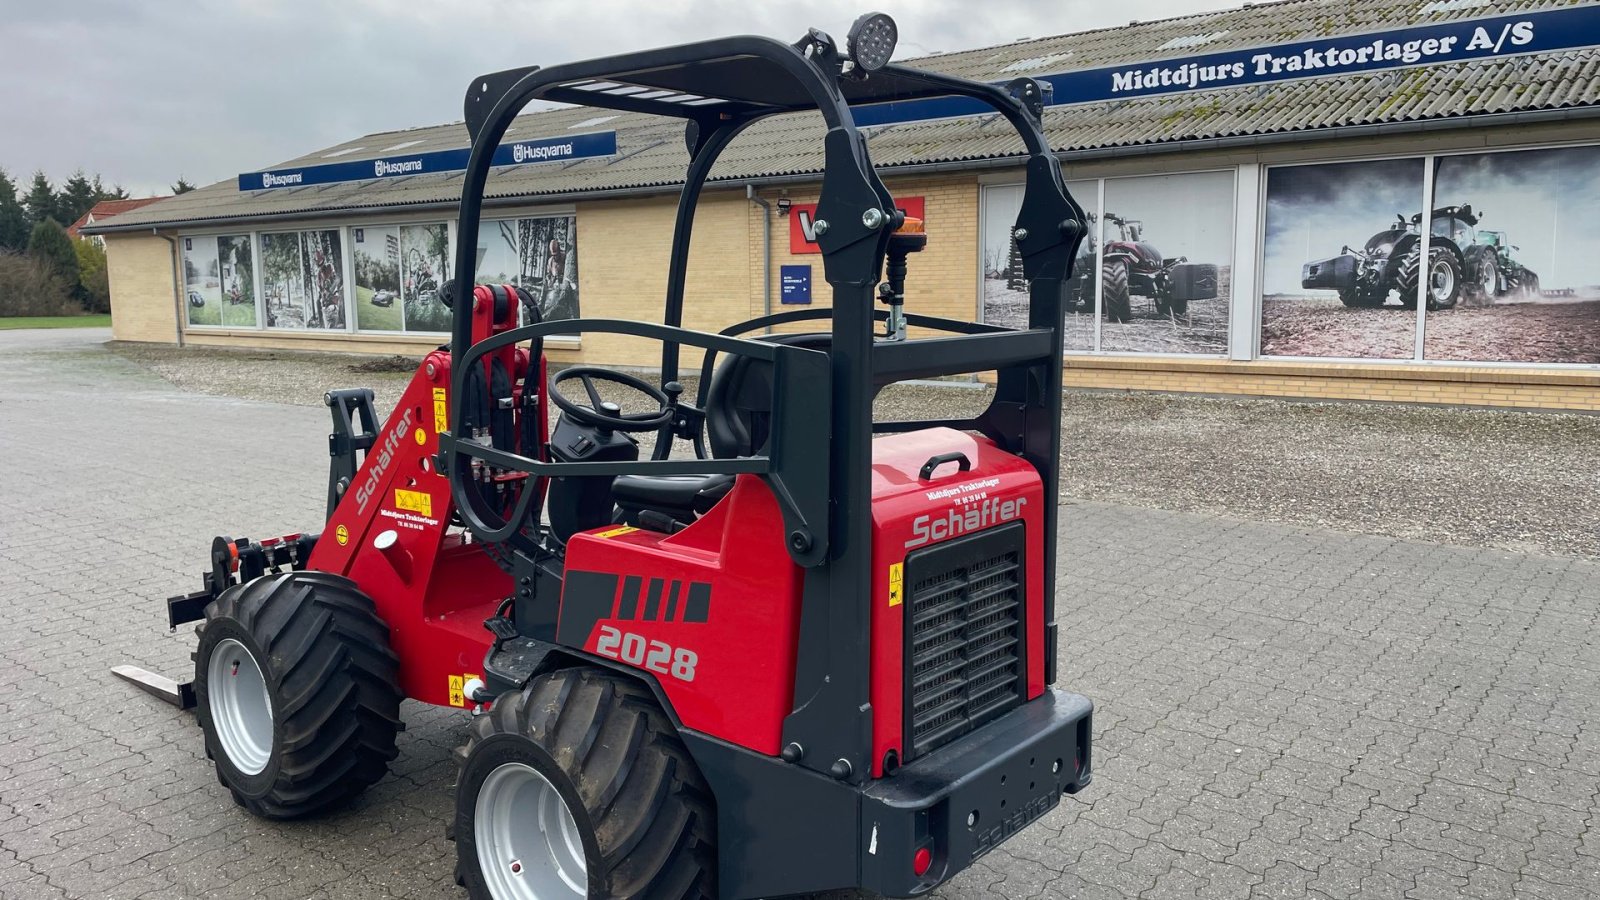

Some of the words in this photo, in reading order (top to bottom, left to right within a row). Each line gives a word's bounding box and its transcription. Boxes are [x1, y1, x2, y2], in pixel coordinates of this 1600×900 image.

[1111, 62, 1245, 92] Midtdjurs
[1251, 35, 1457, 76] Traktorlager
[1465, 21, 1534, 54] A/S
[383, 160, 422, 174] Husqvarna
[524, 144, 572, 159] Husqvarna
[269, 173, 302, 186] Husqvarna
[355, 407, 412, 516] Schäffer
[904, 496, 1027, 549] Schäffer
[596, 624, 698, 683] 2028
